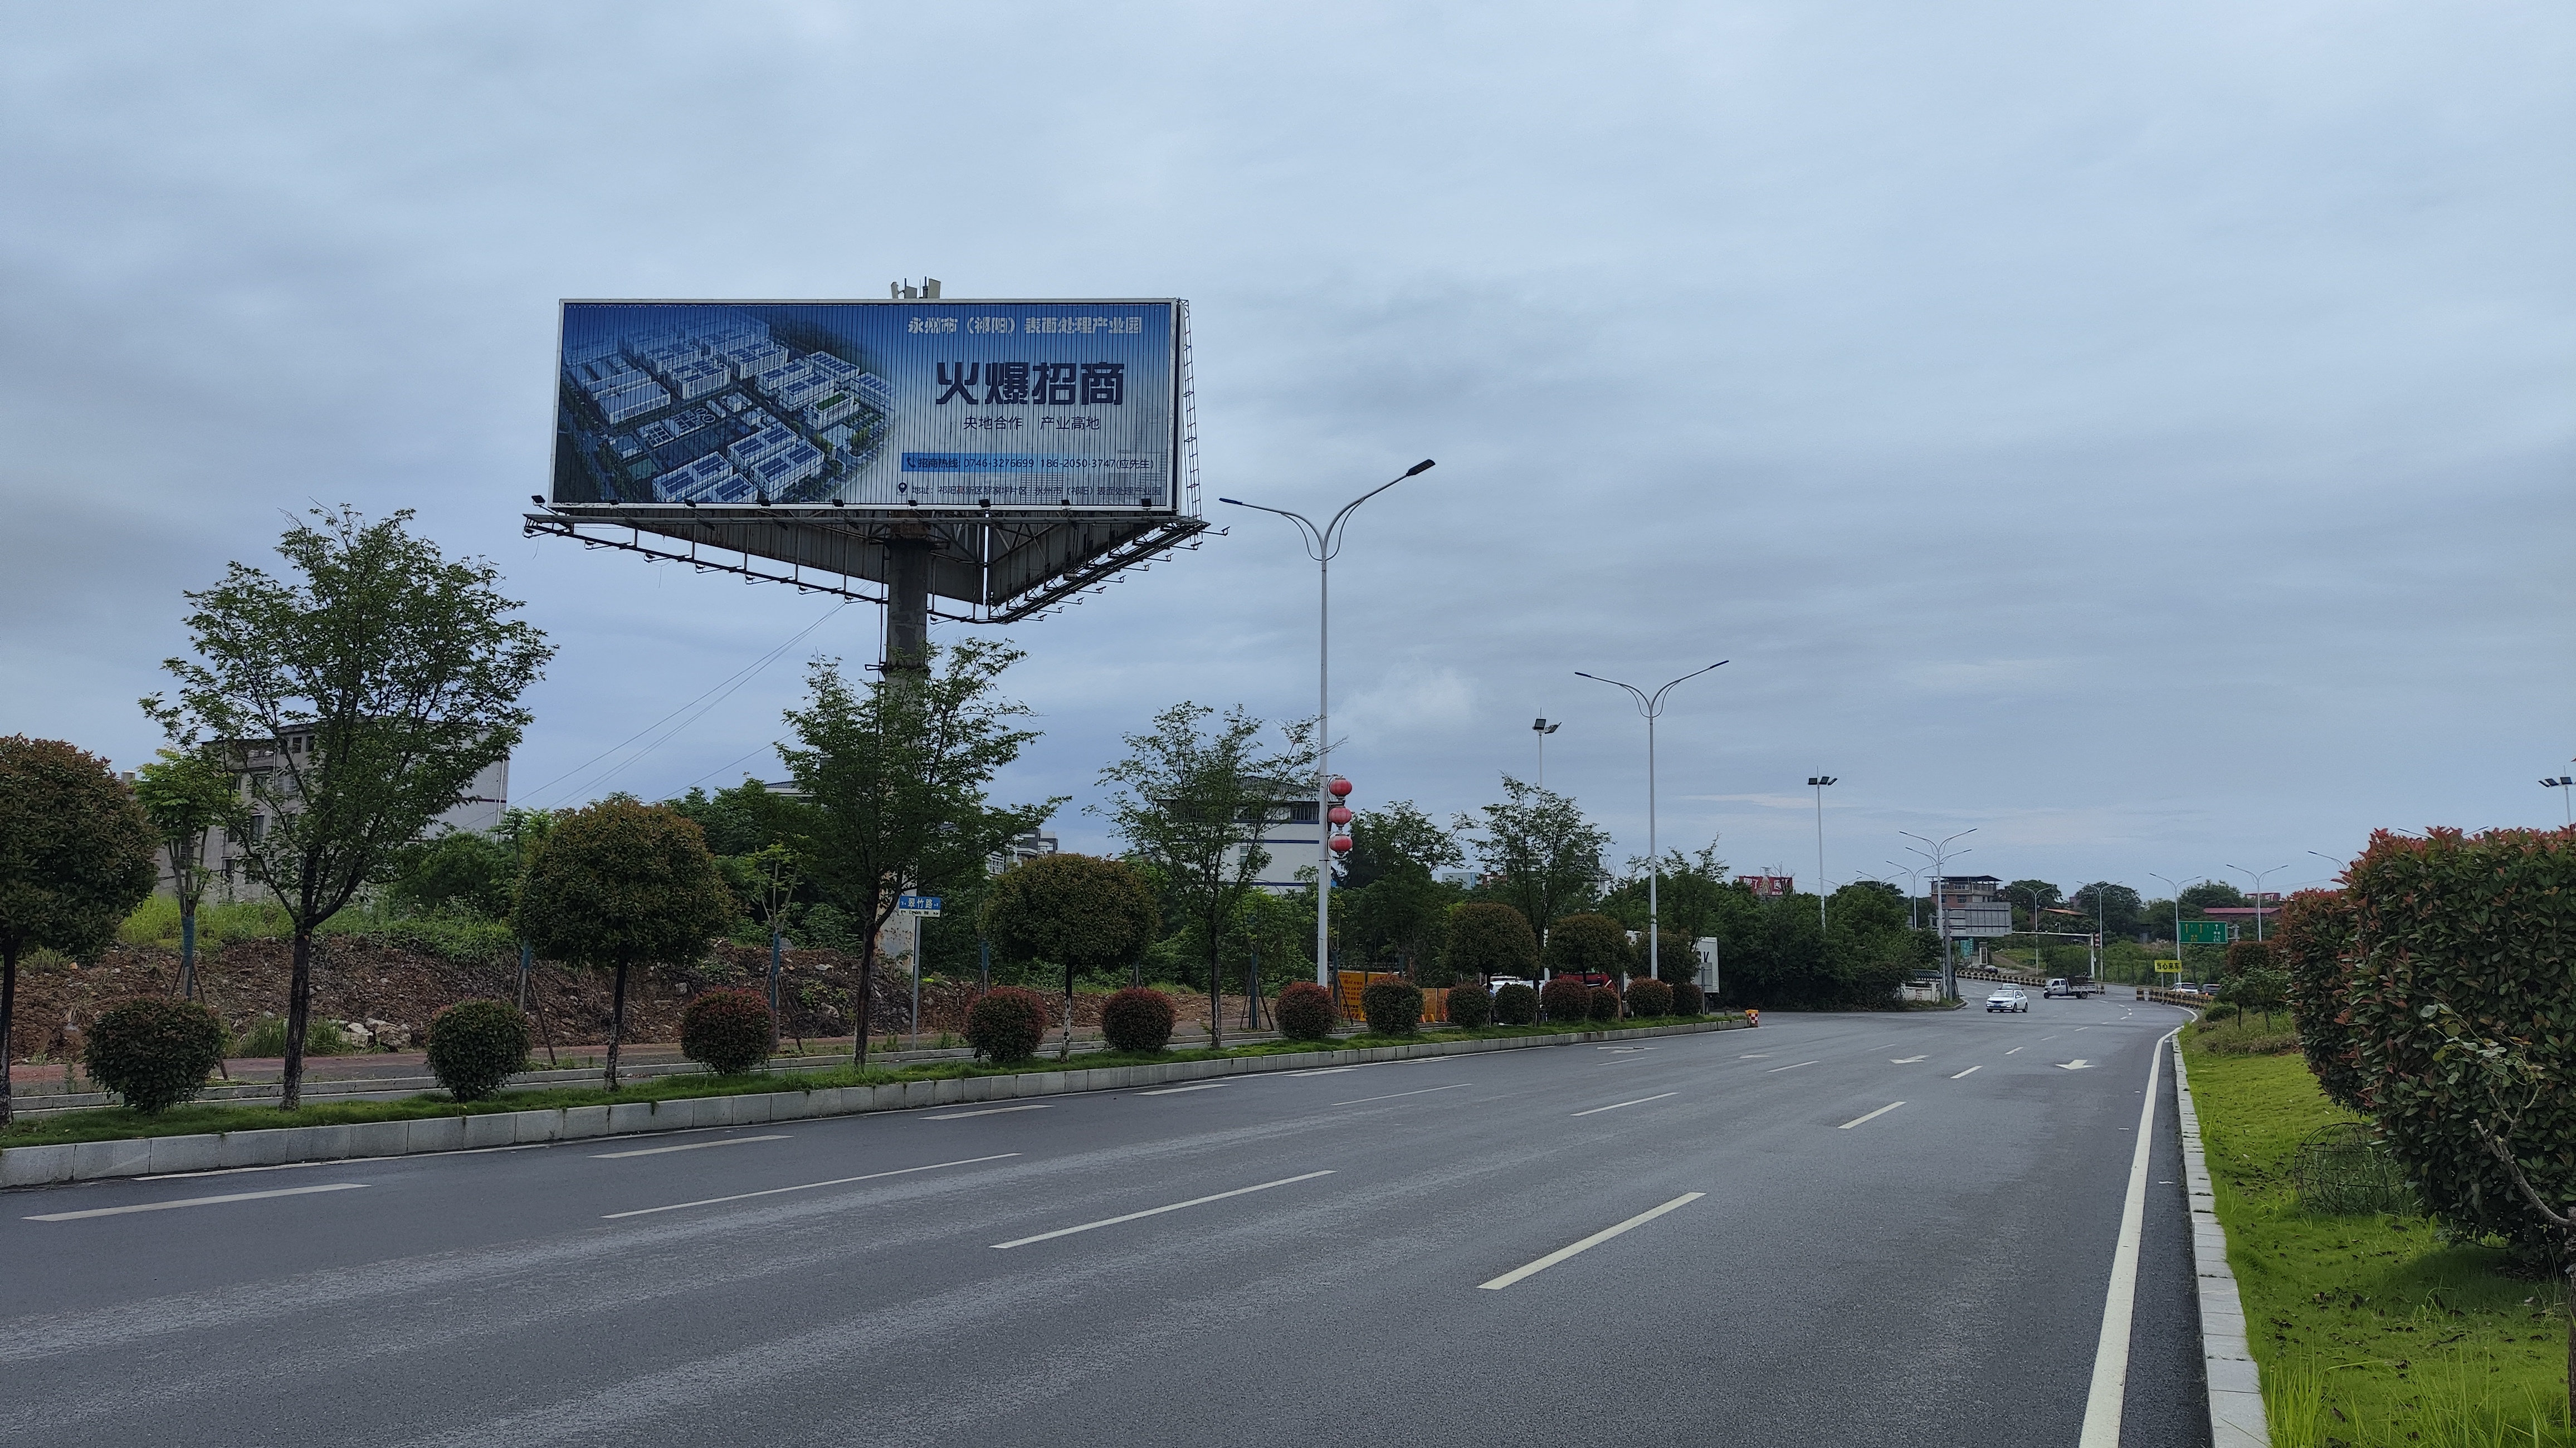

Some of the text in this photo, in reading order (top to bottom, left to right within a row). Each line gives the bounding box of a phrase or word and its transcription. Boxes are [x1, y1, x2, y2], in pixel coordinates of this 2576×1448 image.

[936, 362, 1125, 405] 火爆招商
[963, 416, 1100, 430] 央地合作 产业高地
[908, 898, 933, 909] 翠竹路
